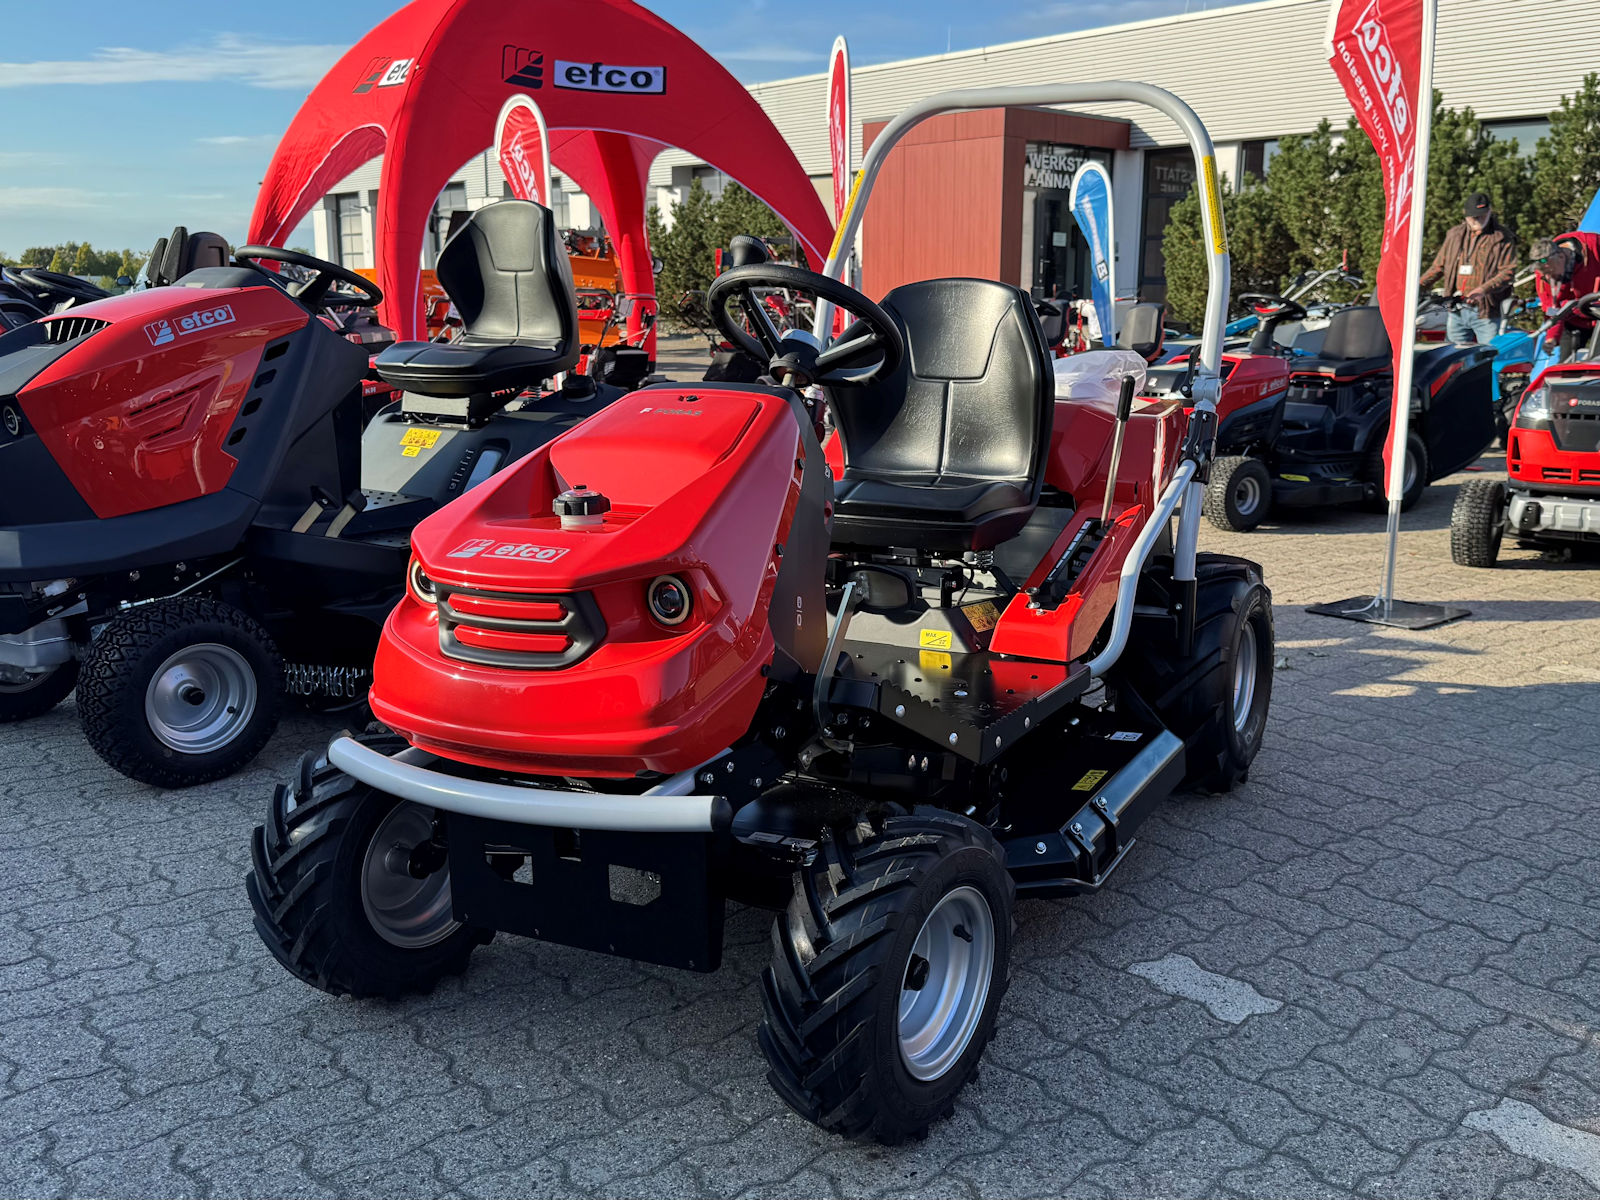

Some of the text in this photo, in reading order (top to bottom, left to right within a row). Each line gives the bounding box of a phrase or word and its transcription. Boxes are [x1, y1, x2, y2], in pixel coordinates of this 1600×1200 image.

[565, 61, 654, 89] efco
[180, 308, 228, 330] efco
[495, 543, 557, 559] efco
